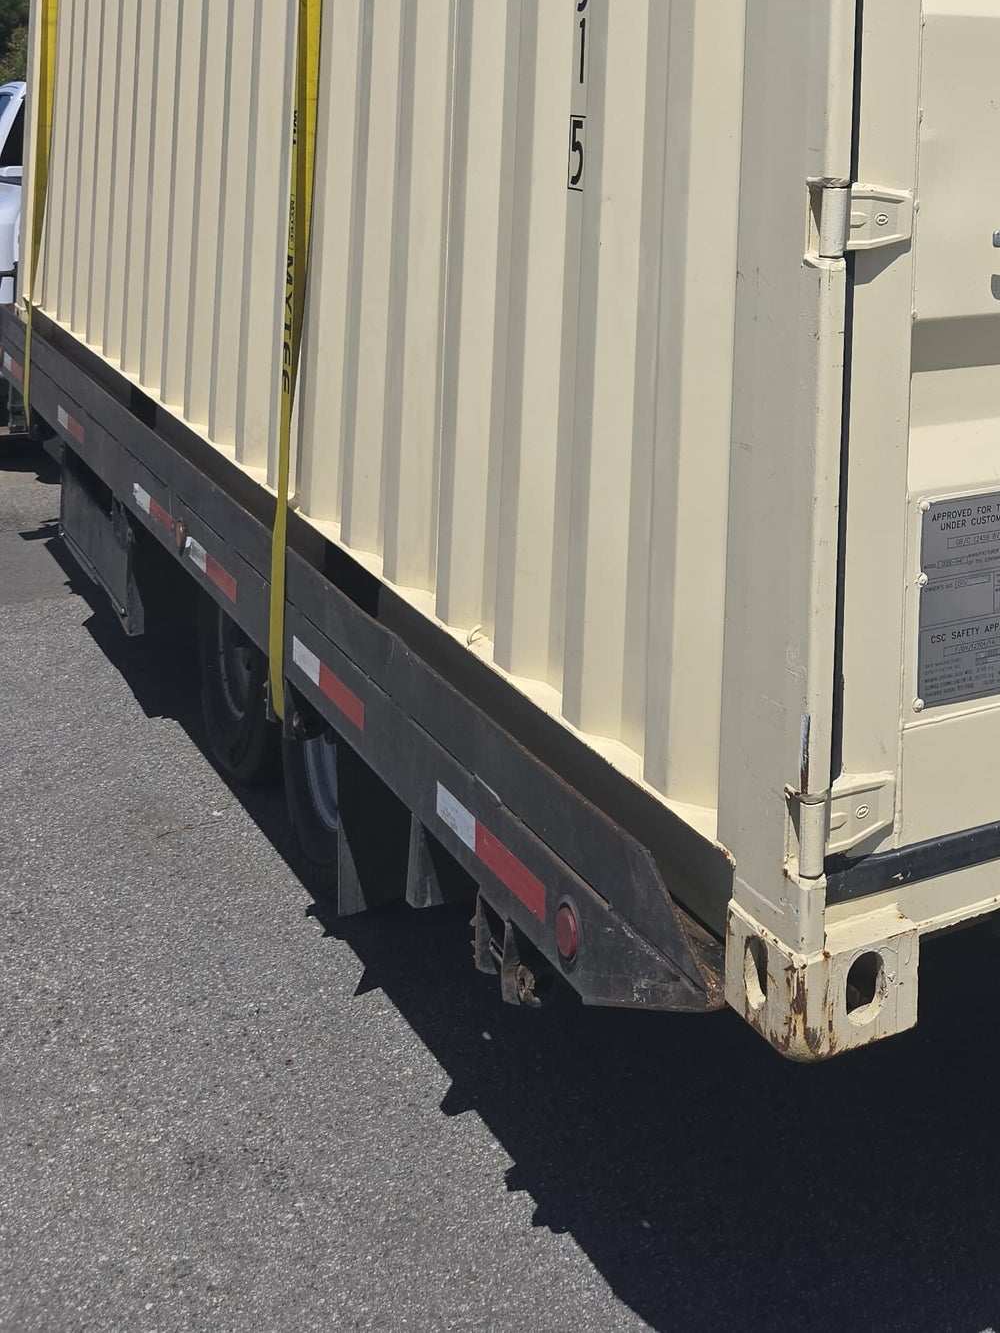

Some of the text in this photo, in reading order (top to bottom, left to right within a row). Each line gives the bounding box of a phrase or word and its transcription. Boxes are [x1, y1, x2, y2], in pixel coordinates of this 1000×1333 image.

[570, 119, 584, 186] 5
[931, 508, 972, 523] APPROVED
[977, 504, 992, 515] FOR
[940, 519, 967, 531] UNDER
[930, 633, 947, 644] CSC
[951, 627, 980, 640] SAFETY
